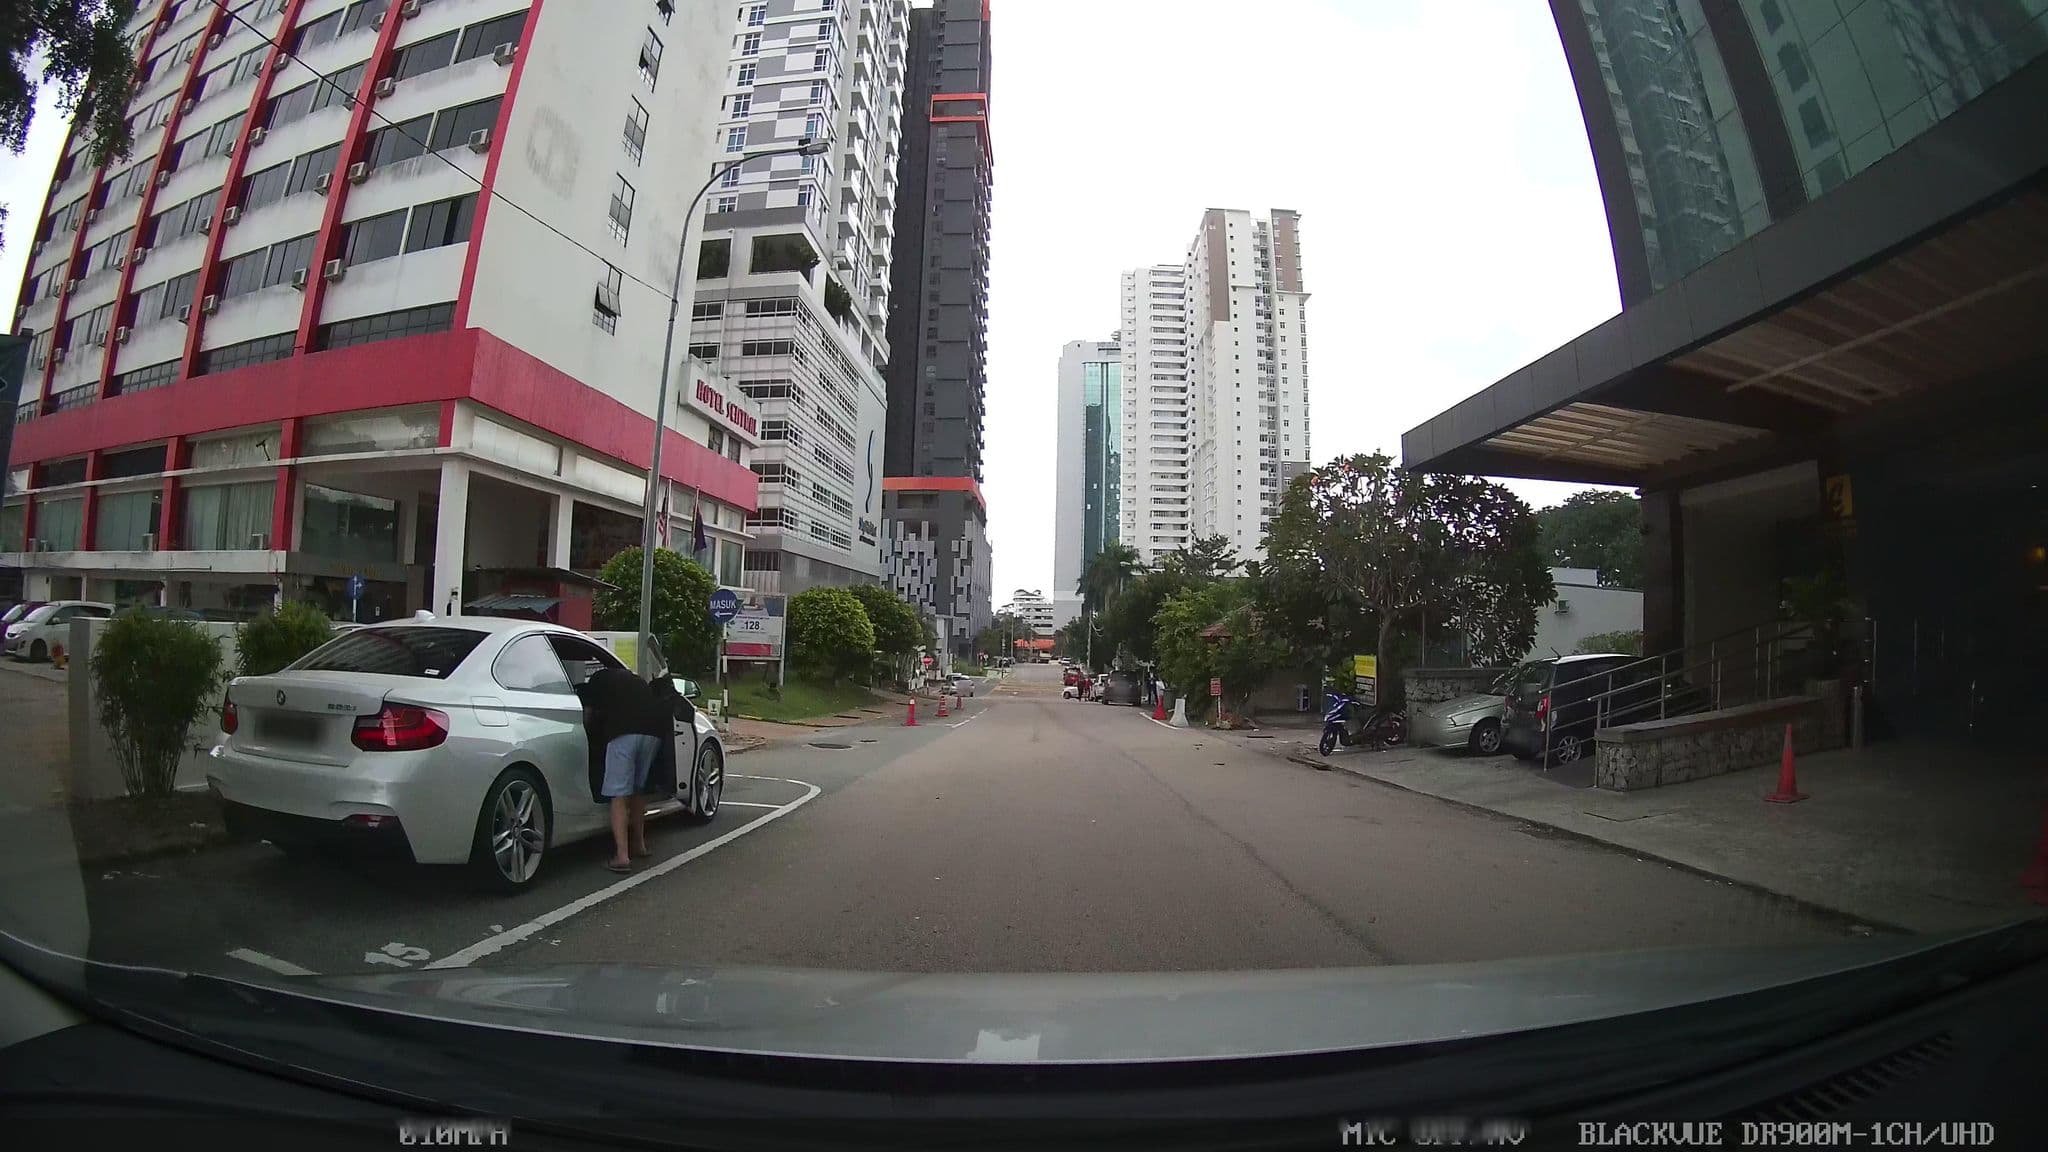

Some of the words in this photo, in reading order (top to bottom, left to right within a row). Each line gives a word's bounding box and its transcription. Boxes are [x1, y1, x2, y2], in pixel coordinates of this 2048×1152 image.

[696, 379, 724, 414] HOTEL
[710, 599, 737, 609] MASUK
[744, 620, 760, 631] 128
